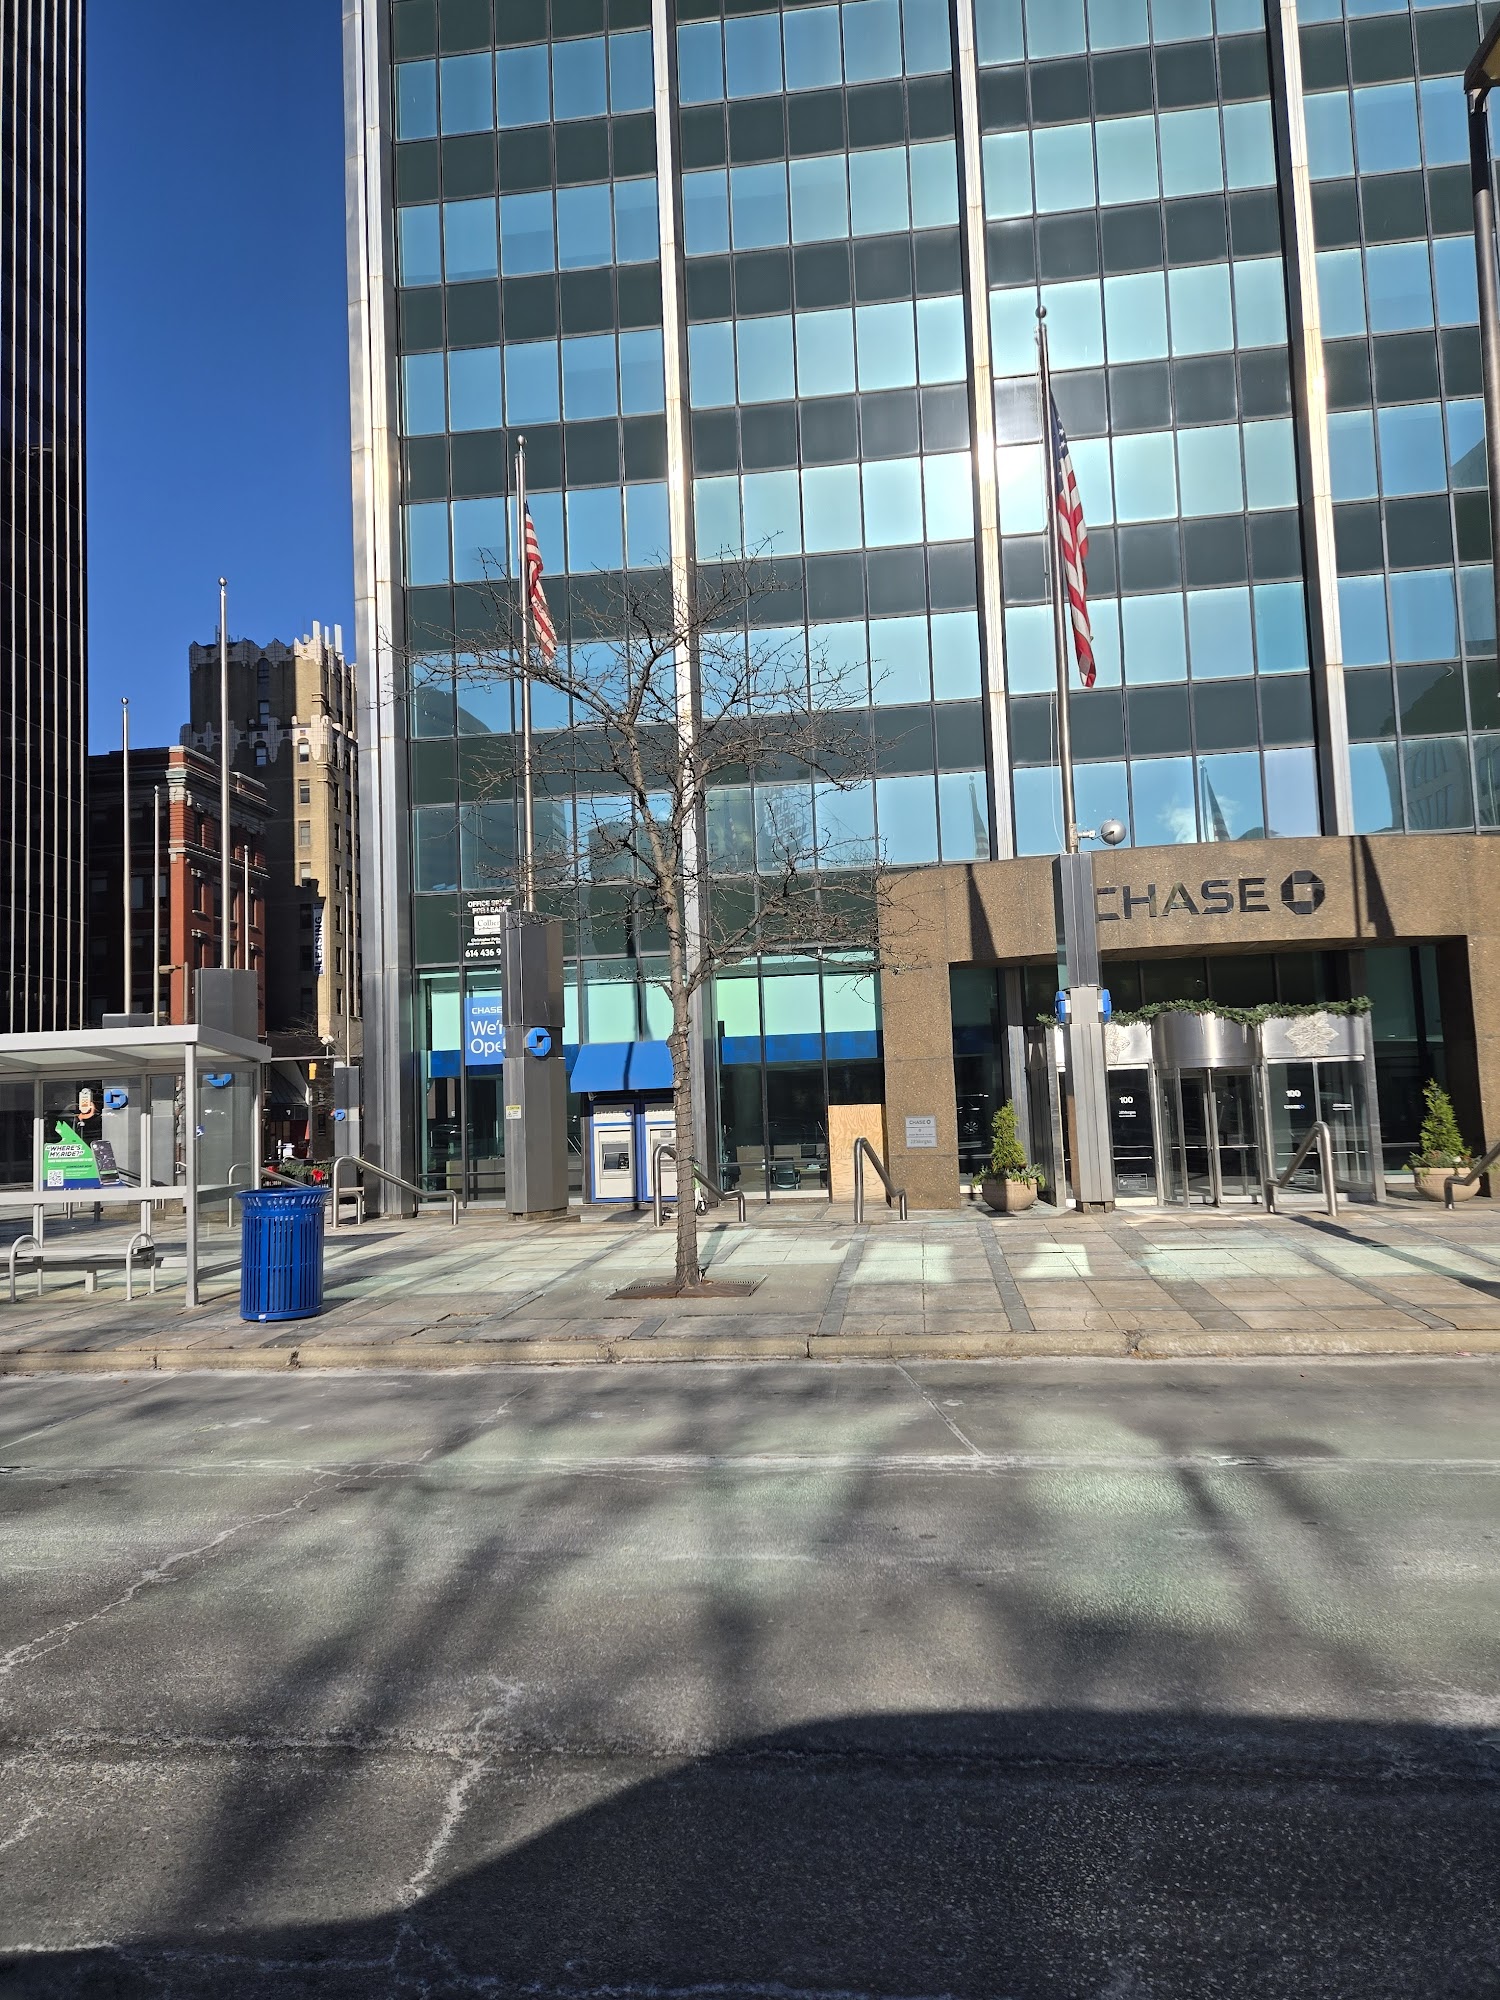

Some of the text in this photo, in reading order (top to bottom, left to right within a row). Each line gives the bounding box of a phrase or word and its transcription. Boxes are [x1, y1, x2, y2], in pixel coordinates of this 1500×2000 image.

[1097, 877, 1270, 921] CHASE
[467, 900, 490, 908] OFFICE
[465, 949, 479, 957] 614
[480, 948, 495, 957] 436
[471, 1006, 502, 1014] CHASE
[1286, 1089, 1302, 1098] 100
[1119, 1095, 1134, 1104] 100
